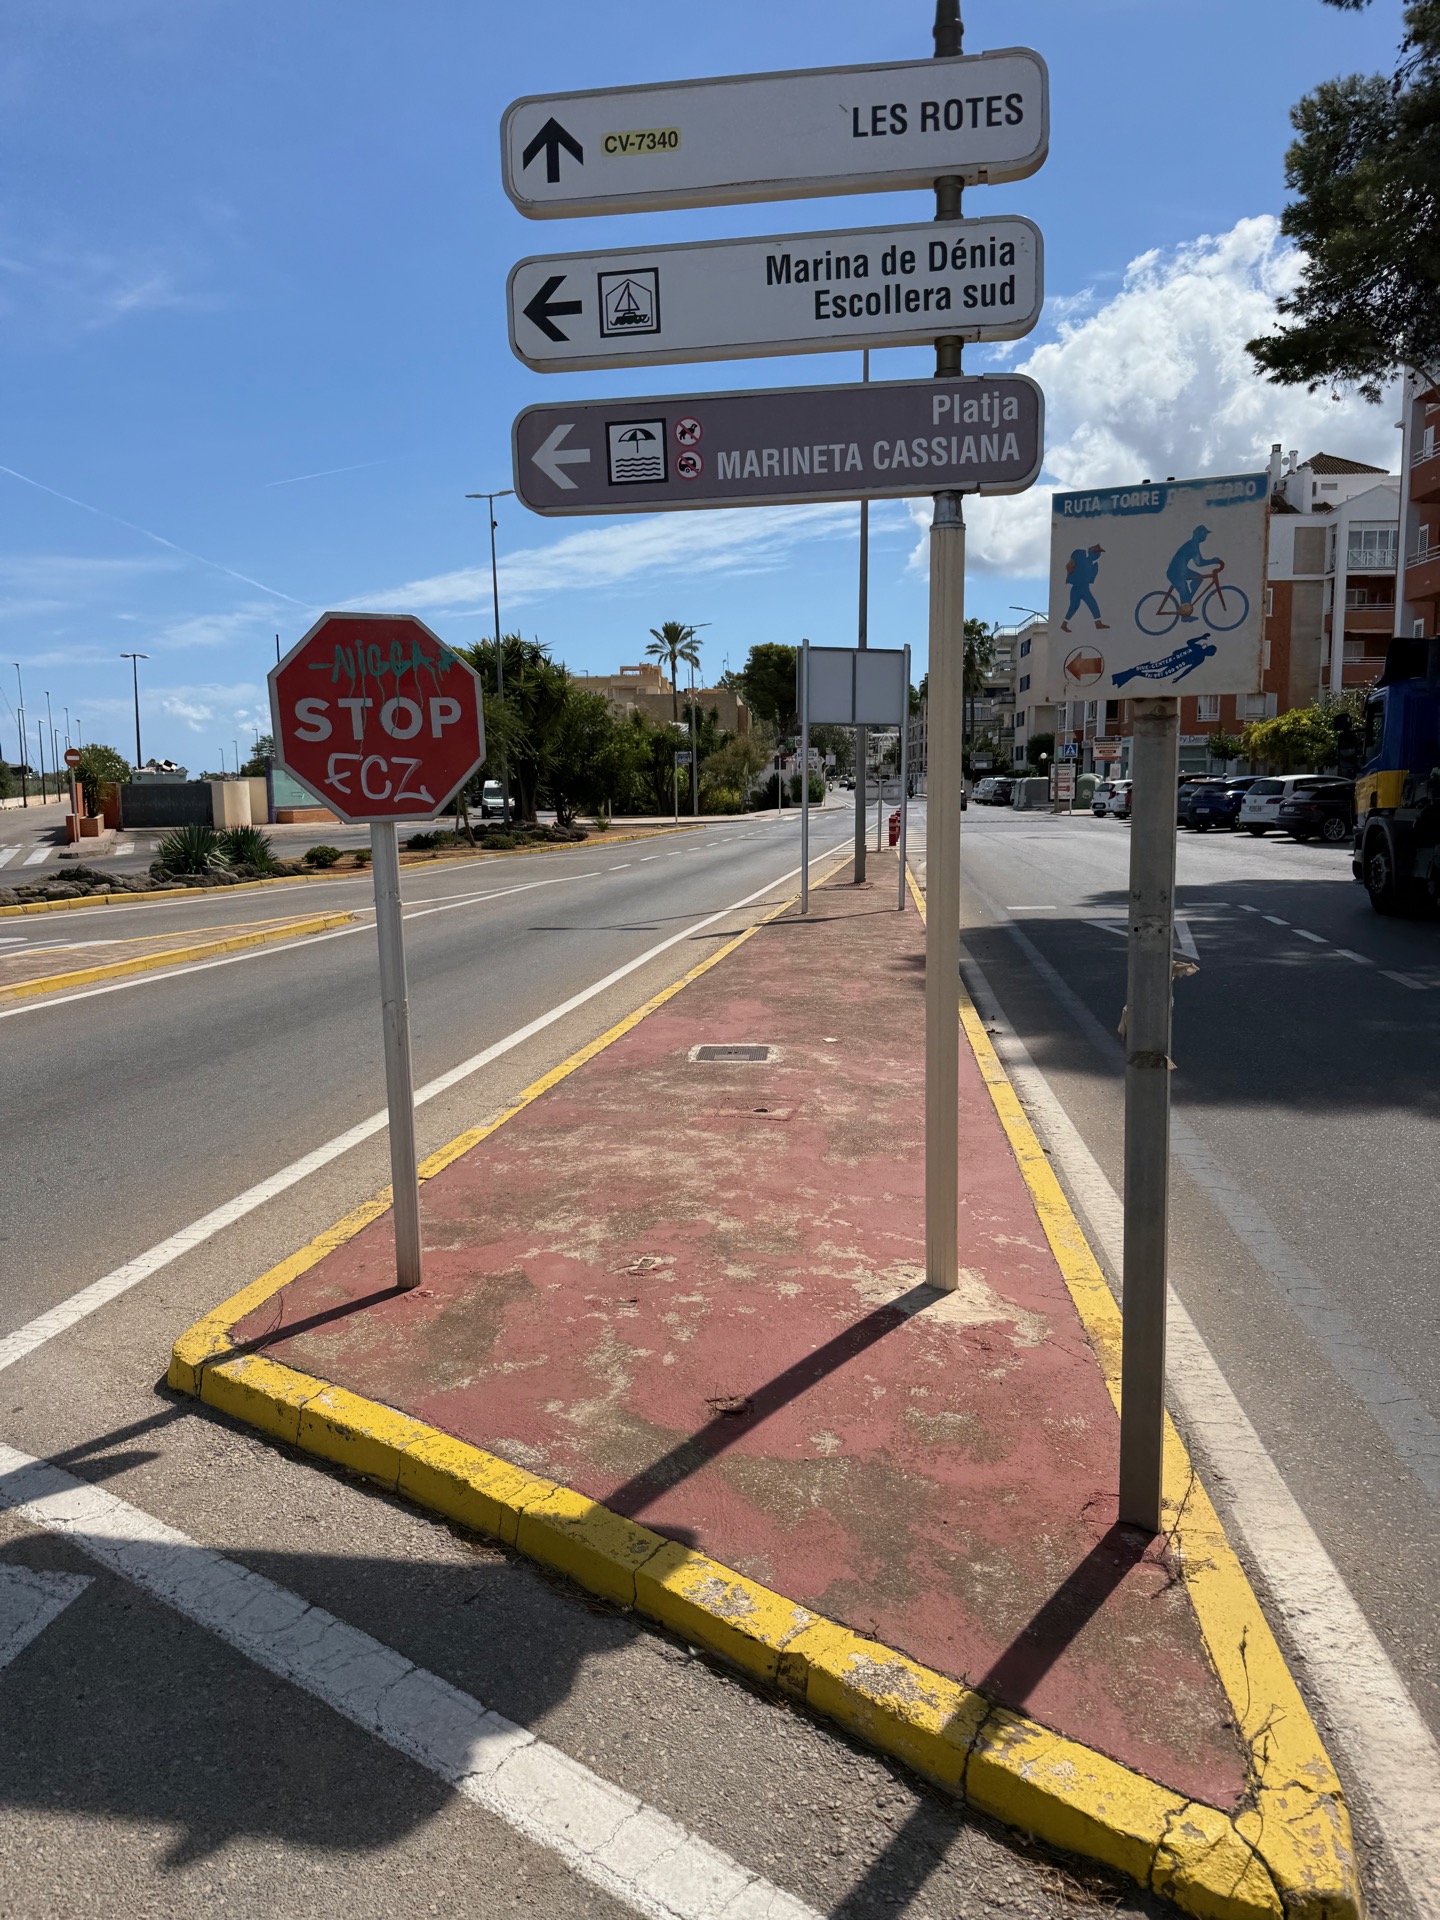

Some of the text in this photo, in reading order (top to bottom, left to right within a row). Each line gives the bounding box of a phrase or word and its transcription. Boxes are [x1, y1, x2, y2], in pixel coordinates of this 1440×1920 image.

[852, 93, 1024, 137] LES ROTES
[604, 131, 679, 153] CV-7340
[766, 236, 1016, 285] Marina de Dénia
[814, 275, 1015, 320] Escollera sud
[932, 391, 1019, 428] Platja
[717, 432, 1020, 480] MARINETA CASSIANA
[1064, 496, 1101, 514] RUTA
[1110, 490, 1160, 509] TORRE
[294, 697, 462, 742] STOP
